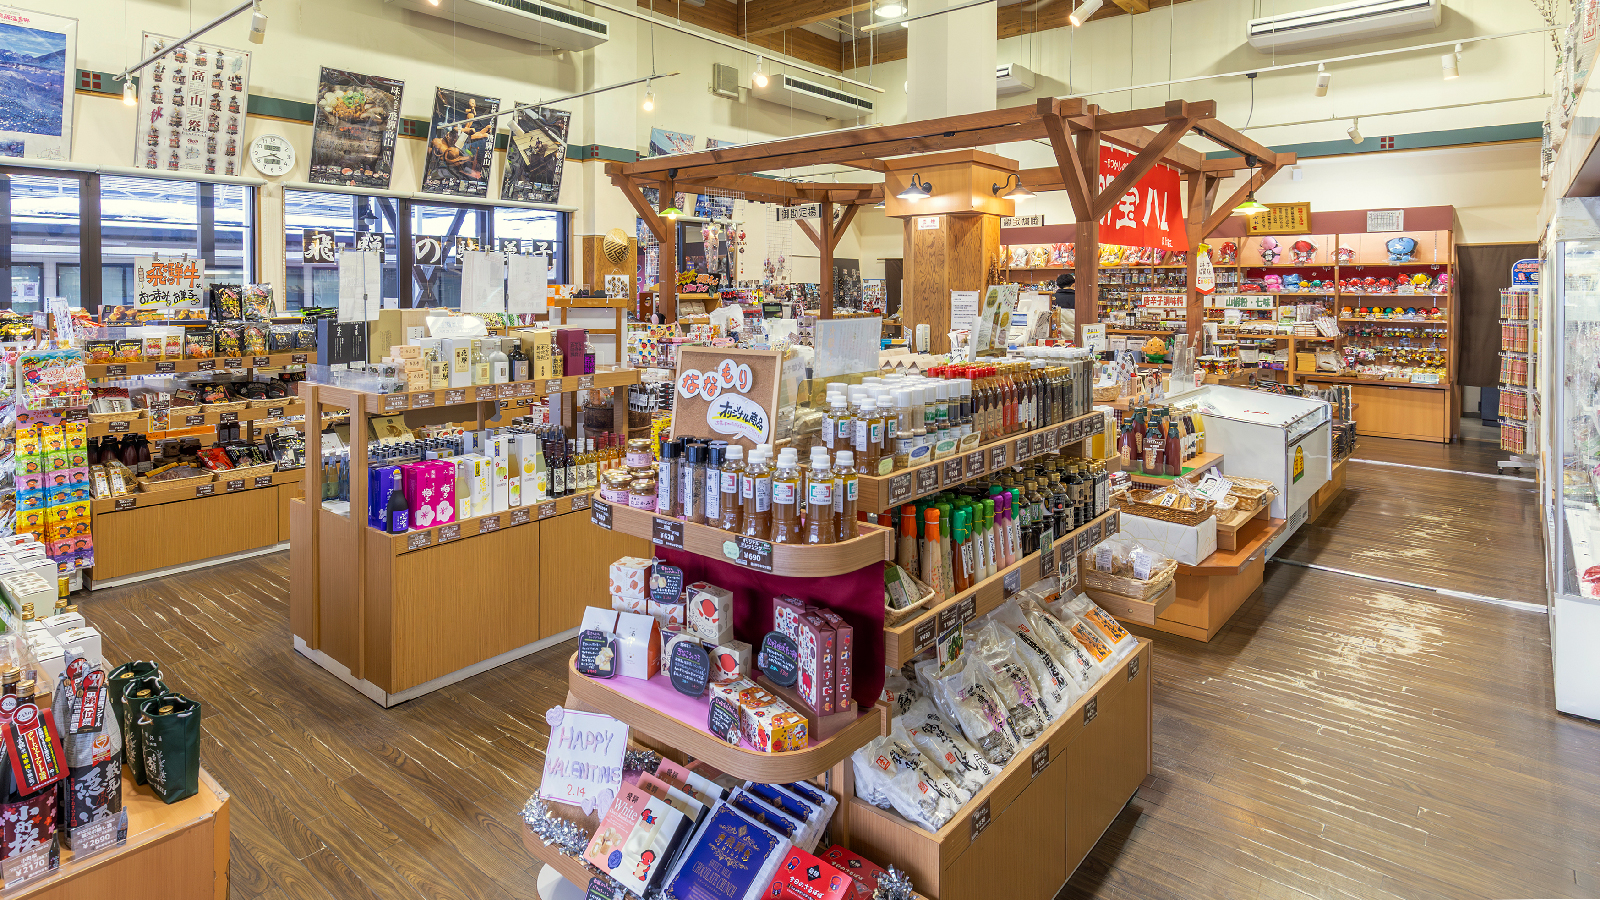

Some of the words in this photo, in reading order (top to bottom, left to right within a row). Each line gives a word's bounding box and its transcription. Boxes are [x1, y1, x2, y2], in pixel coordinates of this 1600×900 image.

[682, 363, 748, 397] ななもり
[719, 400, 764, 431] オリジナル商品
[743, 552, 761, 561] ¥690
[558, 725, 614, 757] HAPPY
[546, 755, 621, 785] VALENTINE
[566, 784, 586, 797] 2.14
[614, 797, 638, 821] White
[8, 805, 41, 857] 小町桜
[82, 833, 111, 849] ¥2690
[15, 859, 45, 876] ¥2170
